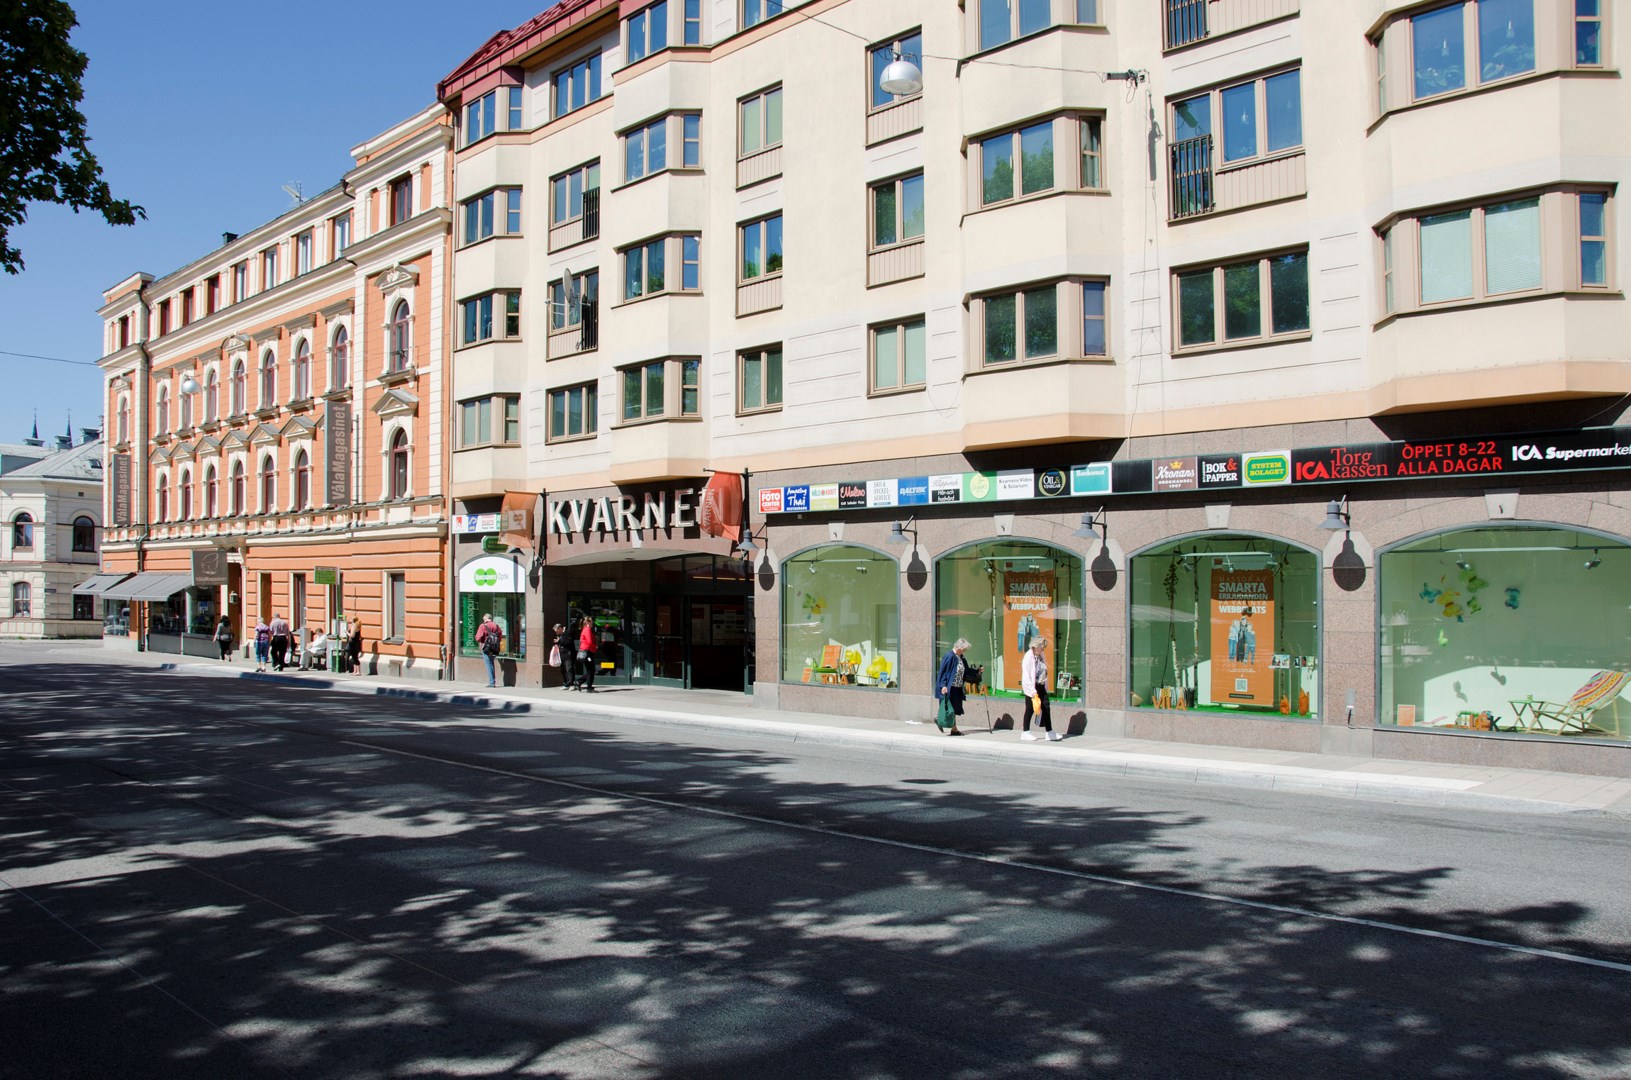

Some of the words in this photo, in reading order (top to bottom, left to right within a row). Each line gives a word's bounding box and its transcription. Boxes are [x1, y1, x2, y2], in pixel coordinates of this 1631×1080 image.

[1331, 447, 1373, 468] Torg
[1402, 443, 1454, 459] ÖPPET
[1512, 444, 1543, 461] ICA
[1155, 465, 1195, 480] Kronans
[1206, 462, 1227, 473] BOK
[1227, 457, 1238, 471] &
[1250, 468, 1284, 476] BOLAGET
[1296, 460, 1331, 481] ICA
[1331, 459, 1388, 479] kassen
[1397, 460, 1438, 475] ALLA
[1443, 456, 1503, 473] DAGAR
[1206, 472, 1238, 483] PAPPER
[761, 492, 780, 502] FOTO
[788, 495, 806, 507] Thai
[1009, 582, 1048, 592] SMARTA
[1219, 582, 1266, 592] SMARTA
